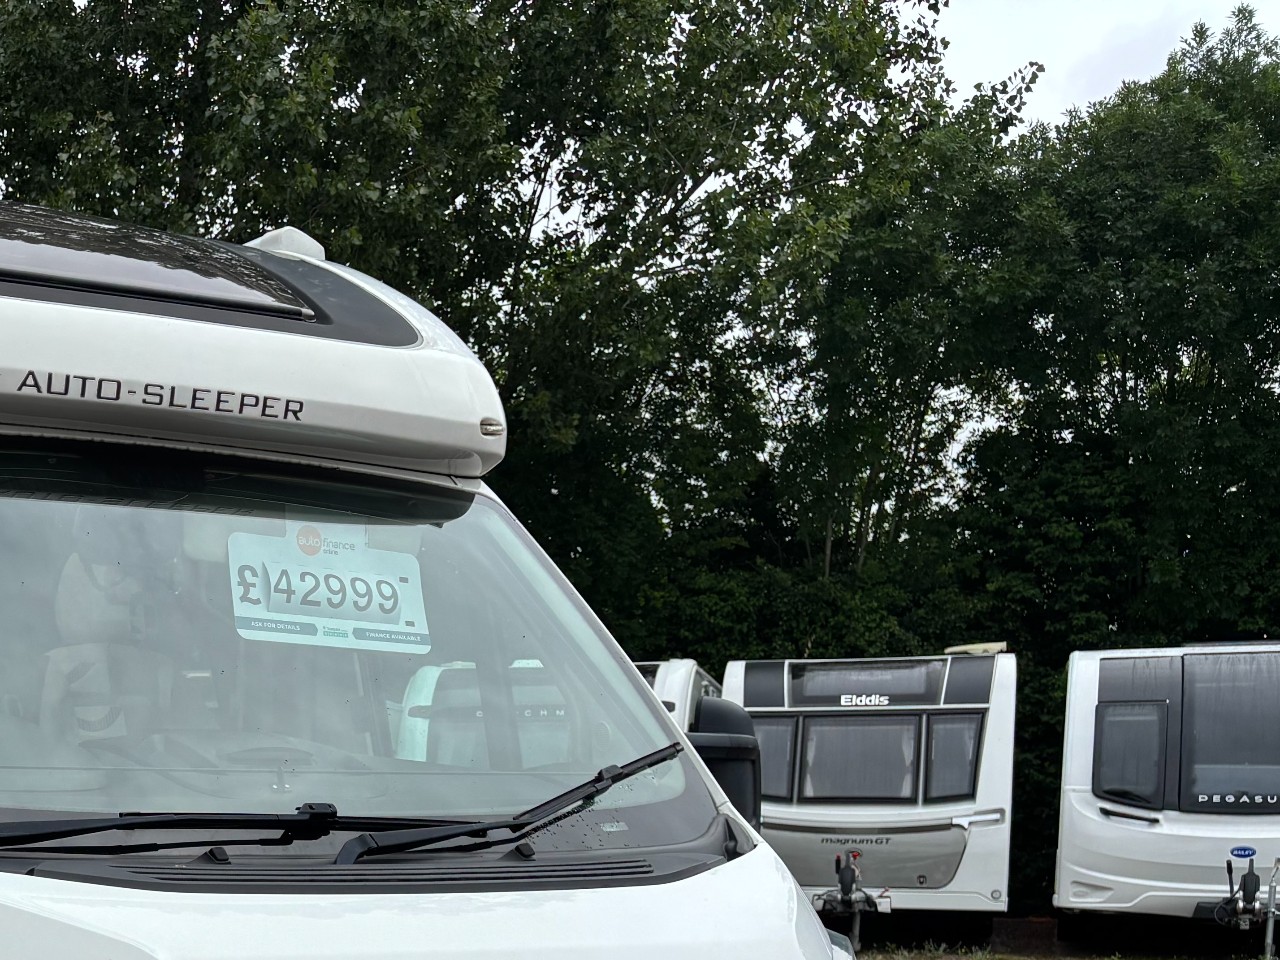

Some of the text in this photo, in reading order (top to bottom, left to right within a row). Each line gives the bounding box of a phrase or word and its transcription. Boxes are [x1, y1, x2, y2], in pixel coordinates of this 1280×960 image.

[17, 370, 304, 421] AUTO-SLEEPER
[322, 537, 355, 550] finance
[365, 631, 390, 639] FINANCE
[840, 694, 890, 706] Elddis
